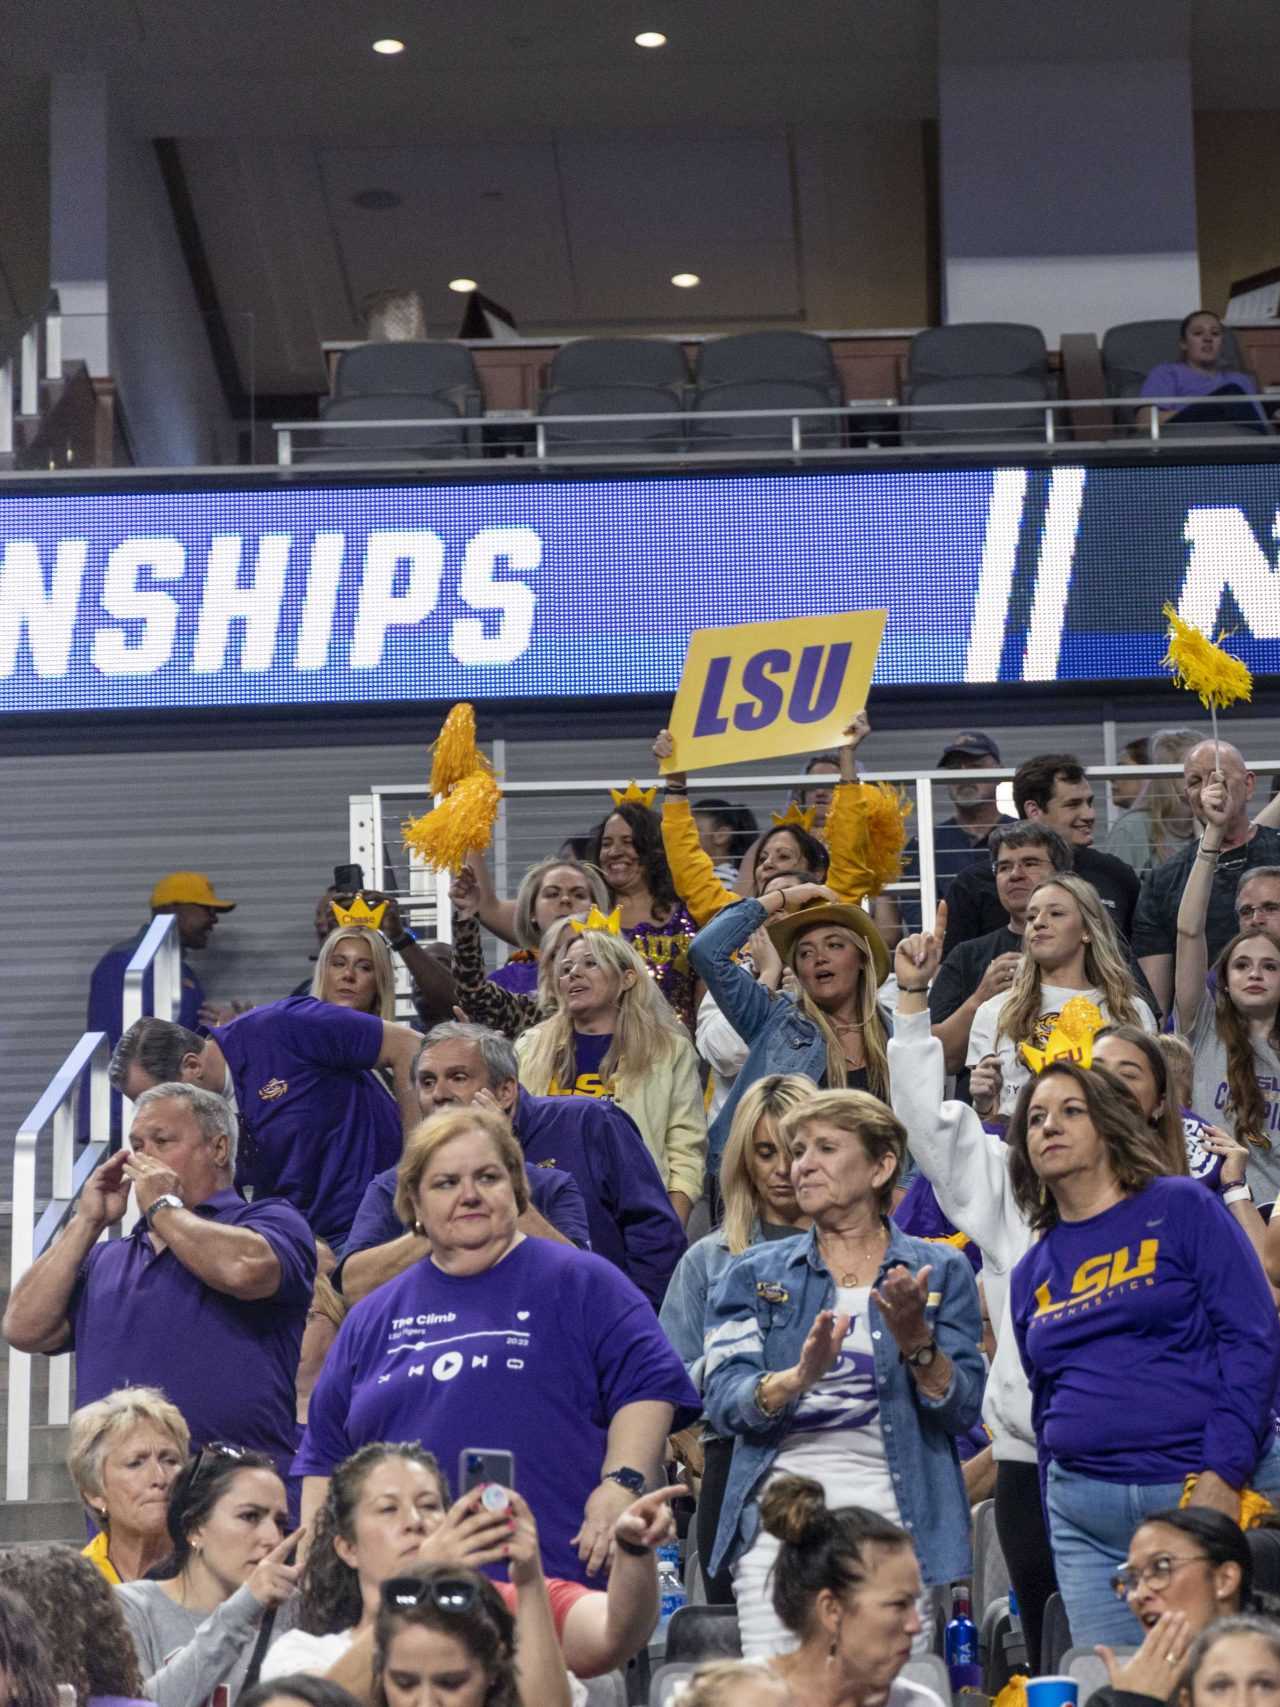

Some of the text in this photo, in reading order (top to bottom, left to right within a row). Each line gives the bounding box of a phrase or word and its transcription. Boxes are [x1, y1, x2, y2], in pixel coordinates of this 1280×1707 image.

[692, 641, 853, 738] LSU
[547, 1072, 616, 1098] LS
[1029, 1278, 1155, 1329] GYMNASTICS
[1034, 1238, 1159, 1318] LSU
[416, 1311, 457, 1325] Climb
